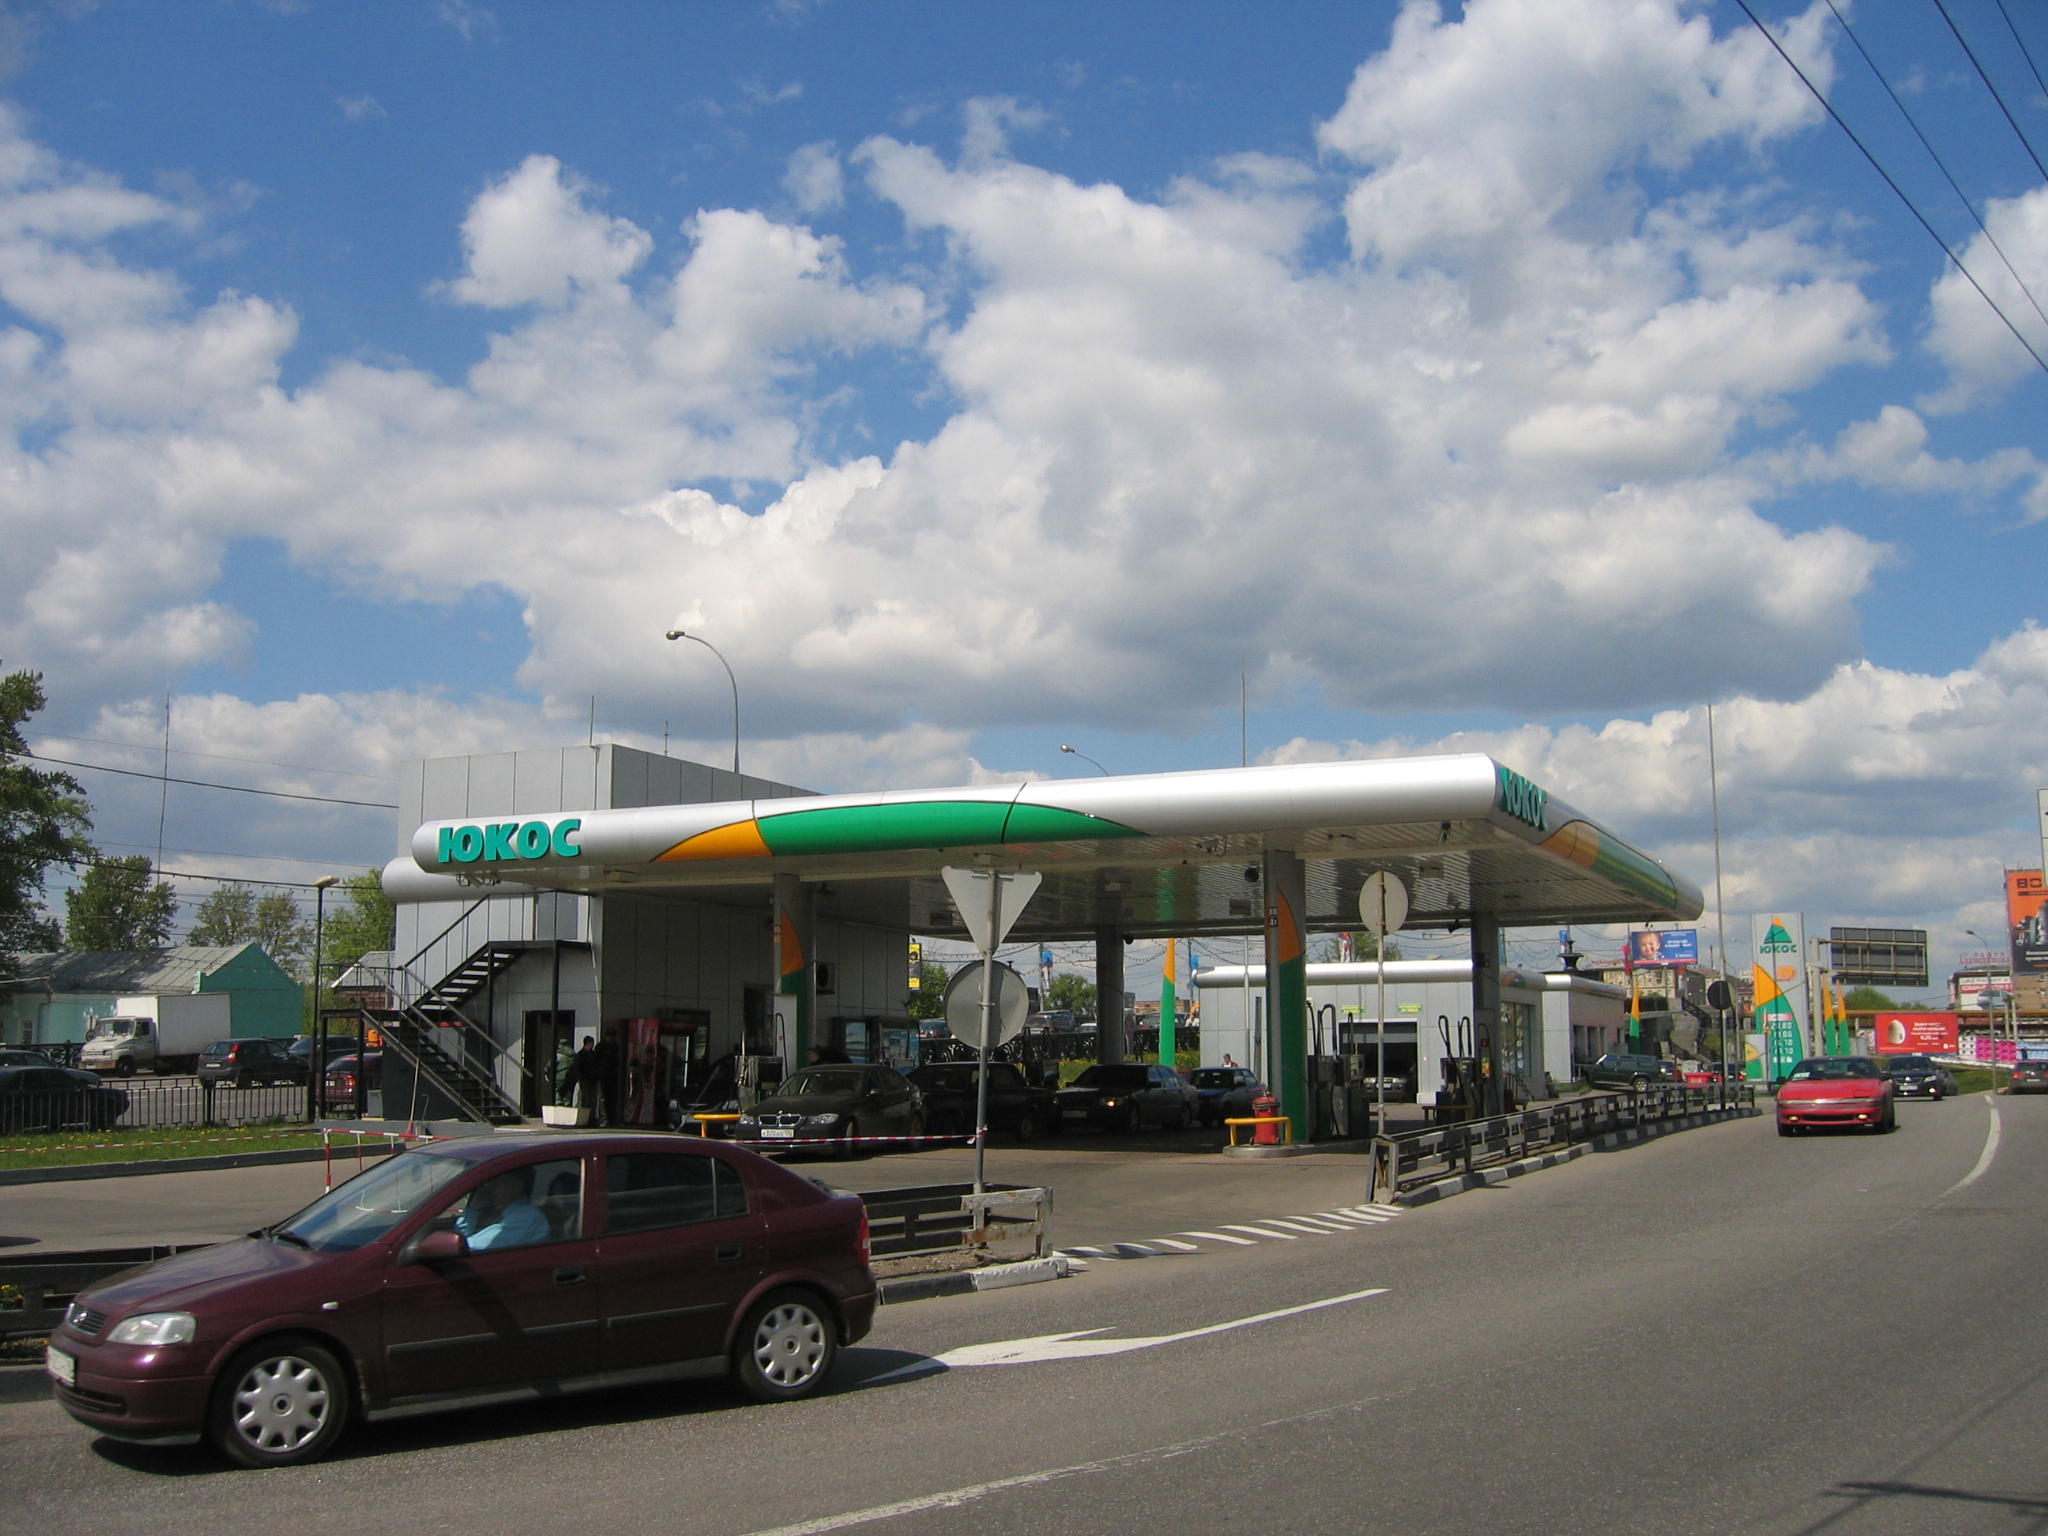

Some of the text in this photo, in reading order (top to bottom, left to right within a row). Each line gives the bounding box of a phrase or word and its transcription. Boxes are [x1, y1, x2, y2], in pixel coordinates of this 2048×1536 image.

[1500, 768, 1548, 831] ЮКОС
[437, 819, 581, 863] ЮКОС
[1760, 944, 1797, 954] ЮКОС
